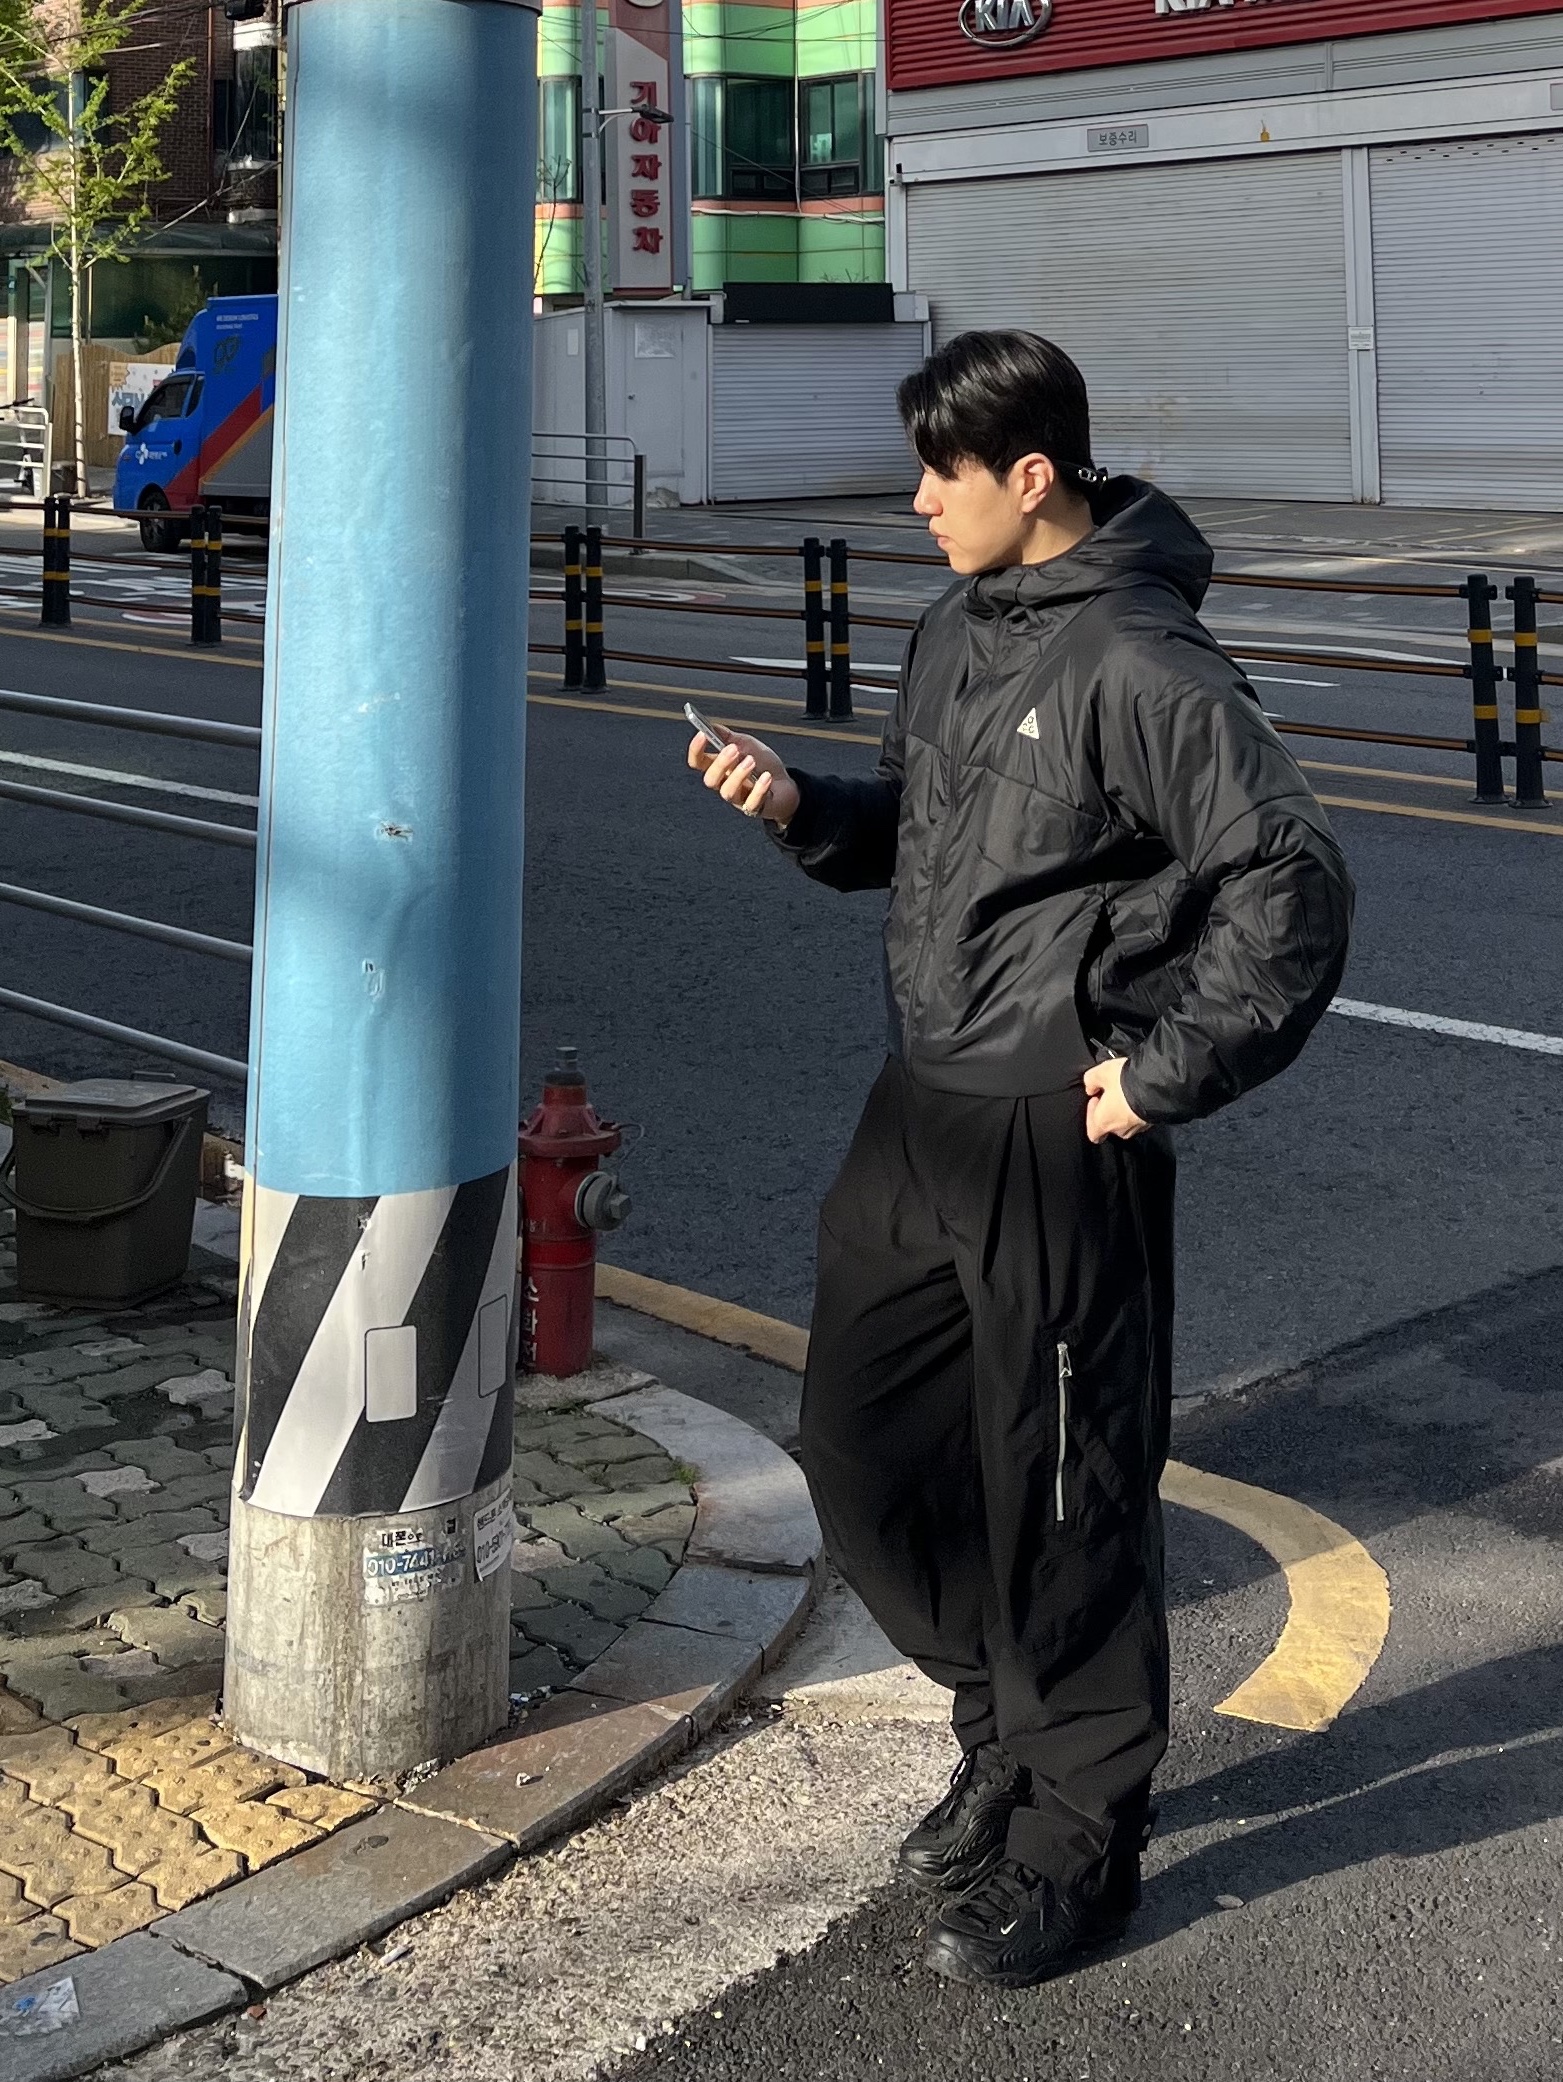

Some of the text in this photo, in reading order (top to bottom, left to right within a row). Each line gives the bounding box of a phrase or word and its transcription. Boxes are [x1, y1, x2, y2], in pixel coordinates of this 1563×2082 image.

[975, 0, 1035, 31] KIA
[1099, 130, 1137, 146] 보증수리
[630, 81, 663, 254] 기아자동차
